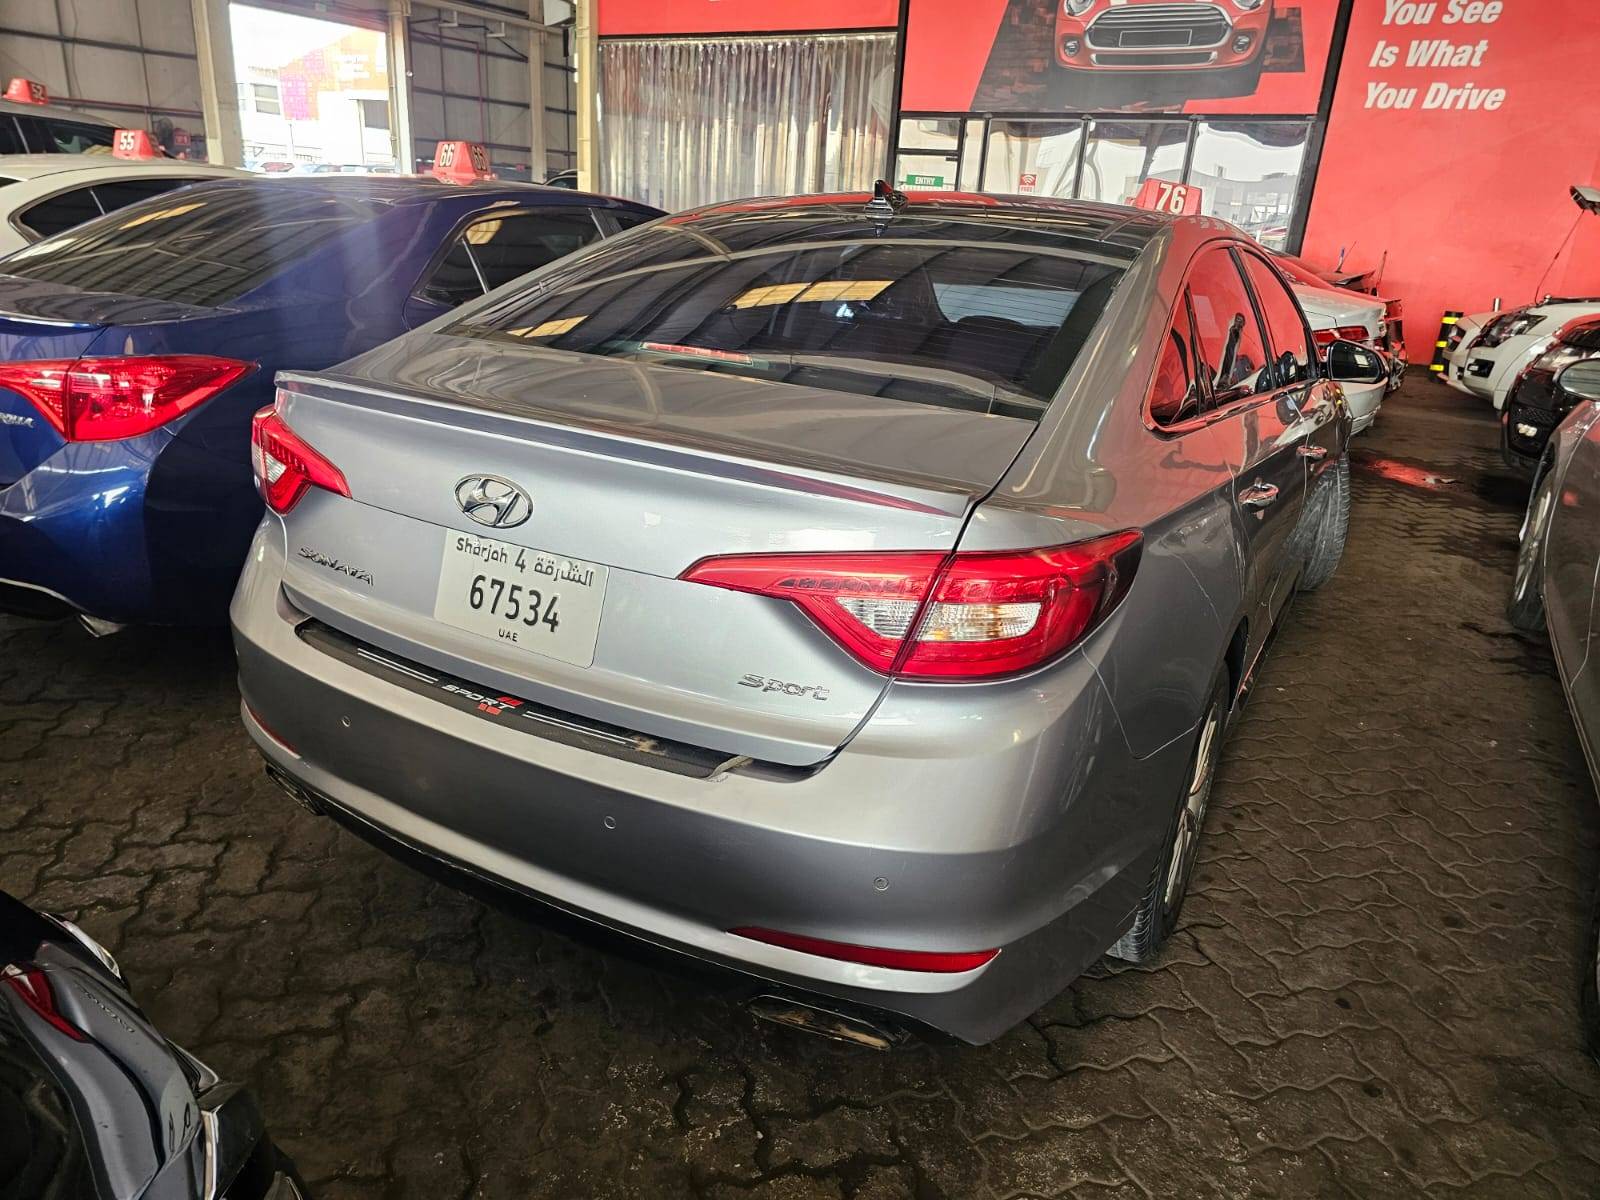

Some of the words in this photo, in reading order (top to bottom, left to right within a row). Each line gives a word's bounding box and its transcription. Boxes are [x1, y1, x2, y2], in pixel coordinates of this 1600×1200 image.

[1382, 0, 1437, 25] You
[1442, 0, 1503, 24] See
[1368, 40, 1400, 67] Is
[1405, 39, 1489, 67] What
[1364, 81, 1418, 109] You
[1421, 82, 1506, 110] Drive
[119, 131, 136, 151] 55
[439, 143, 455, 168] 66
[914, 176, 936, 185] ENTRY
[1155, 182, 1187, 215] 76
[297, 546, 374, 587] SONATA
[456, 536, 509, 563] Sharjah
[514, 548, 527, 573] 4
[469, 574, 560, 633] 67534
[498, 628, 519, 643] UAE
[440, 684, 517, 710] SPORT
